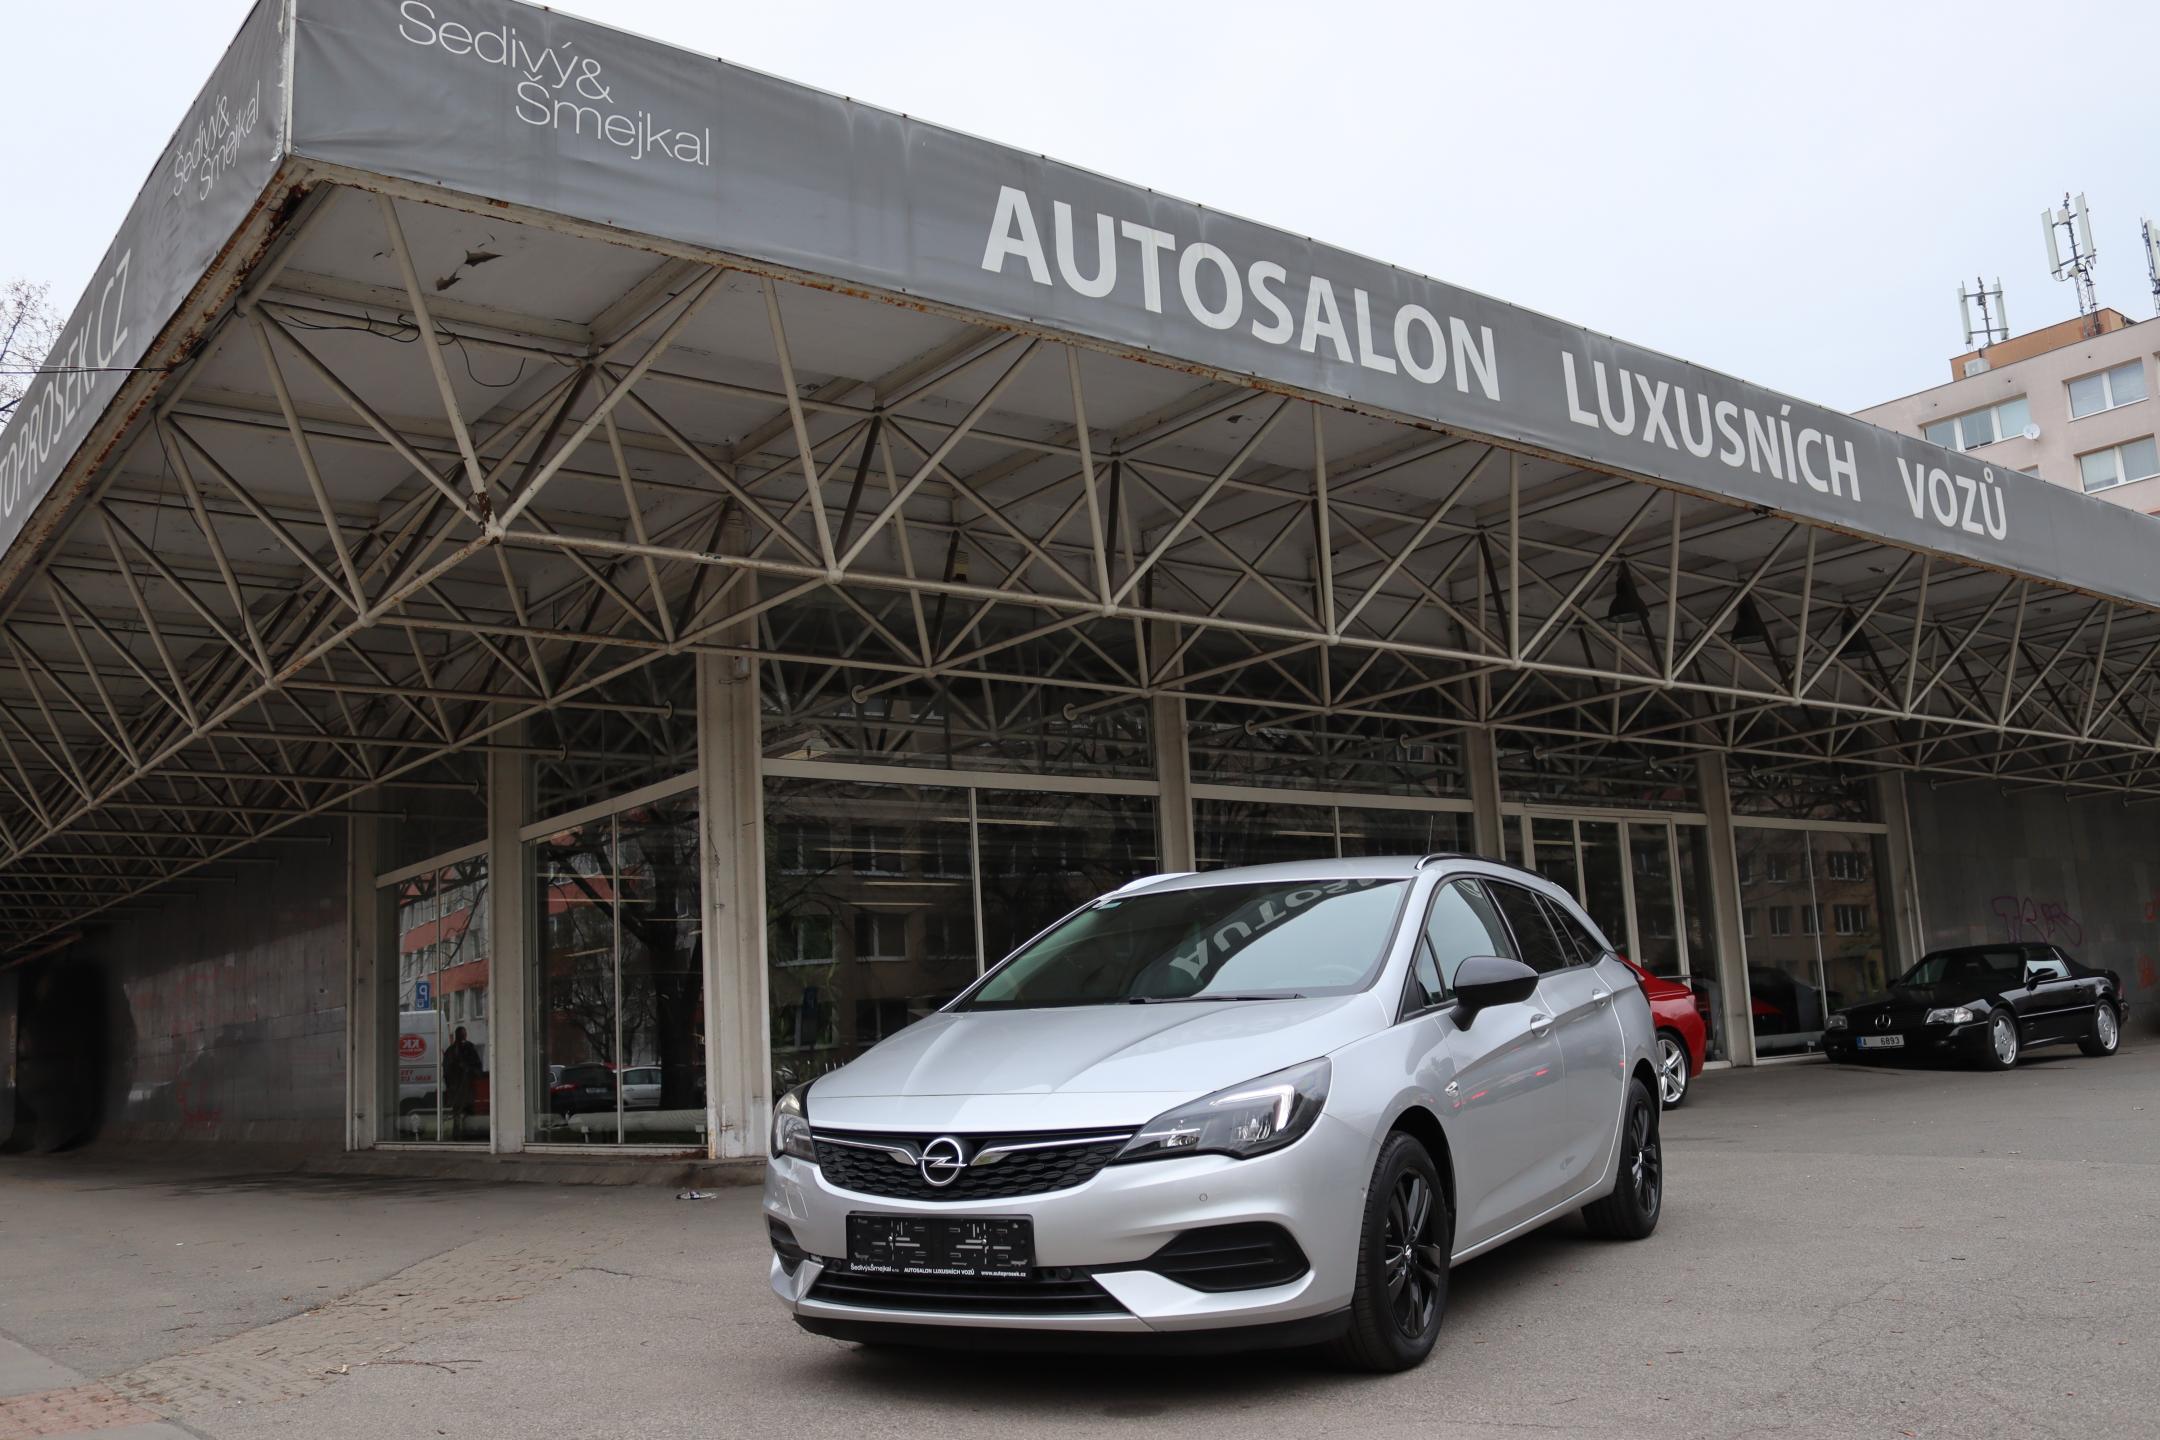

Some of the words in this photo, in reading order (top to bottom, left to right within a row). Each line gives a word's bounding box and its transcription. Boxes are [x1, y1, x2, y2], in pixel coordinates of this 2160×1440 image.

[174, 94, 230, 196] Šedivý&
[200, 80, 260, 200] Šmejkal
[516, 71, 709, 166] Šmejkal
[981, 185, 1500, 401] AUTOSALON
[1561, 350, 1862, 502] LUXUSNÍCH
[1896, 456, 2008, 541] VOZŮ
